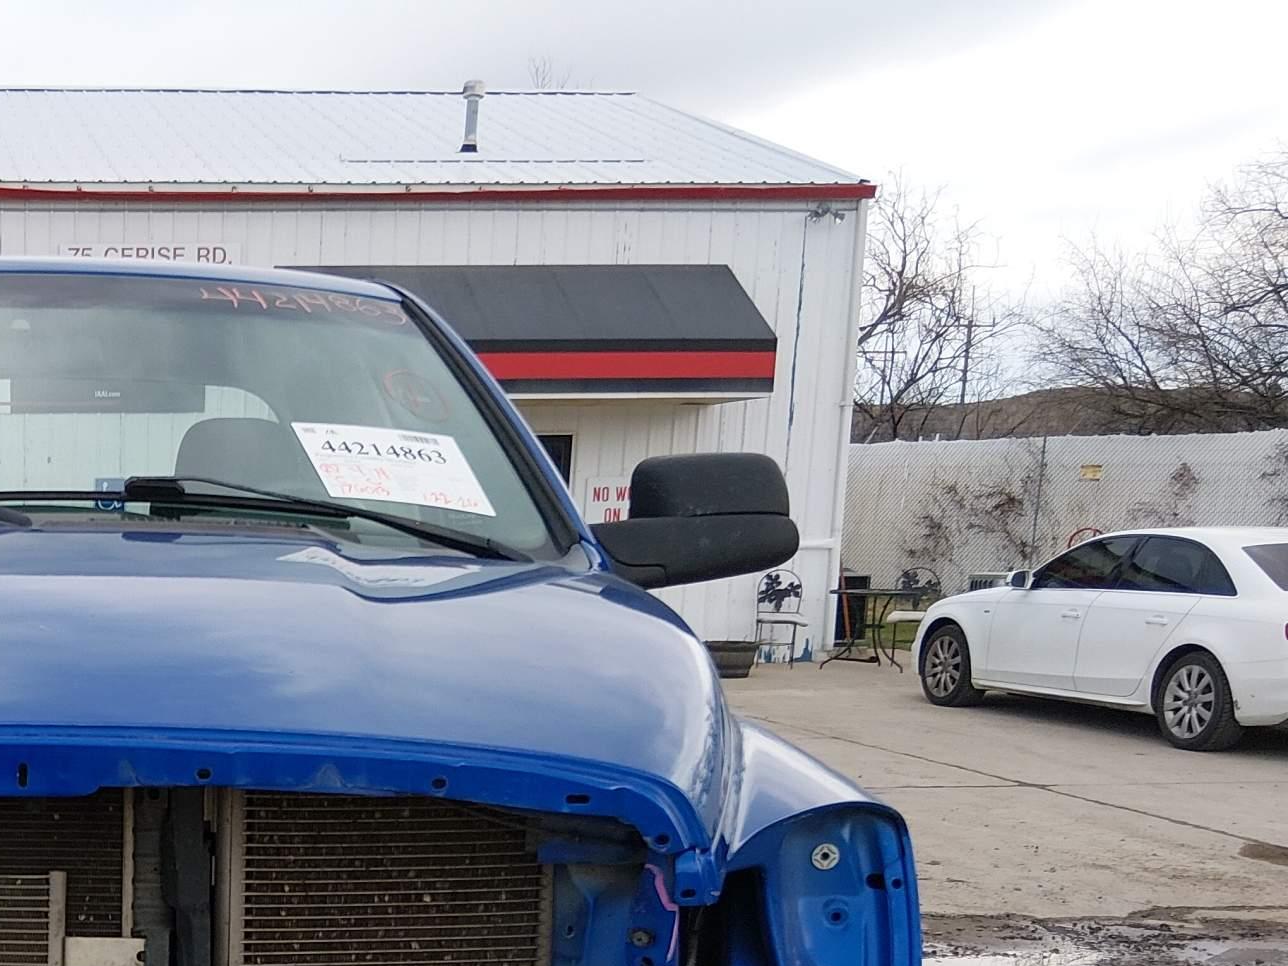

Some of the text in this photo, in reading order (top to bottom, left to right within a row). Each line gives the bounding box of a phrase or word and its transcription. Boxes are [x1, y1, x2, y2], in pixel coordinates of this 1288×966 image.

[320, 439, 447, 465] 44214863
[592, 486, 610, 502] NO
[603, 508, 621, 523] ON
